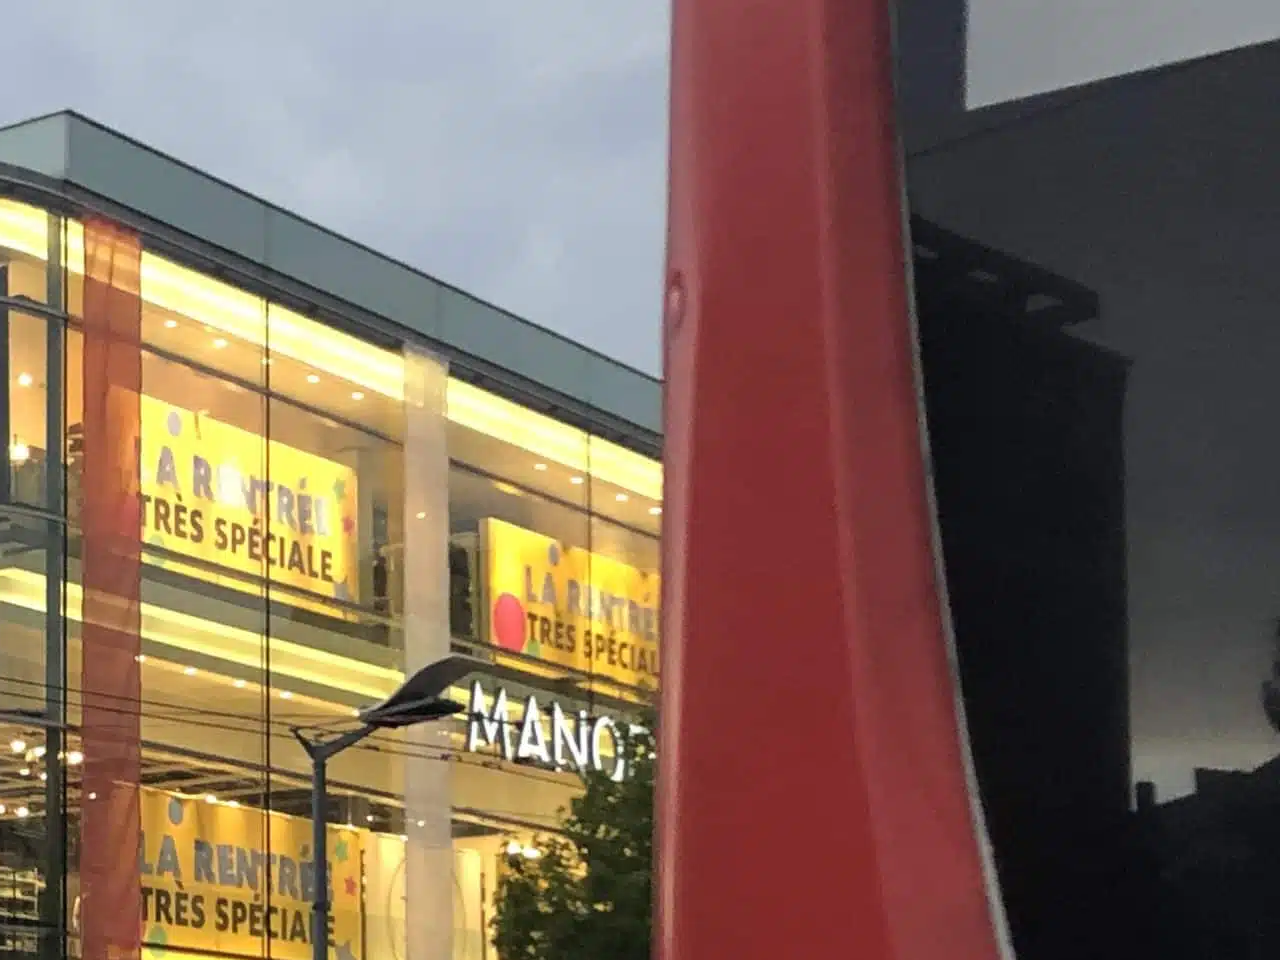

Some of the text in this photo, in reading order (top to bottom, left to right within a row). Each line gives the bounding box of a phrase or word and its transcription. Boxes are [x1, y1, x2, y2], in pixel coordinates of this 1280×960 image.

[137, 491, 334, 582] TRÈS SPÉCIALE
[527, 607, 576, 653] TRÈS
[470, 680, 656, 782] MANO
[138, 832, 181, 880] LA
[140, 880, 206, 929] TRÈS
